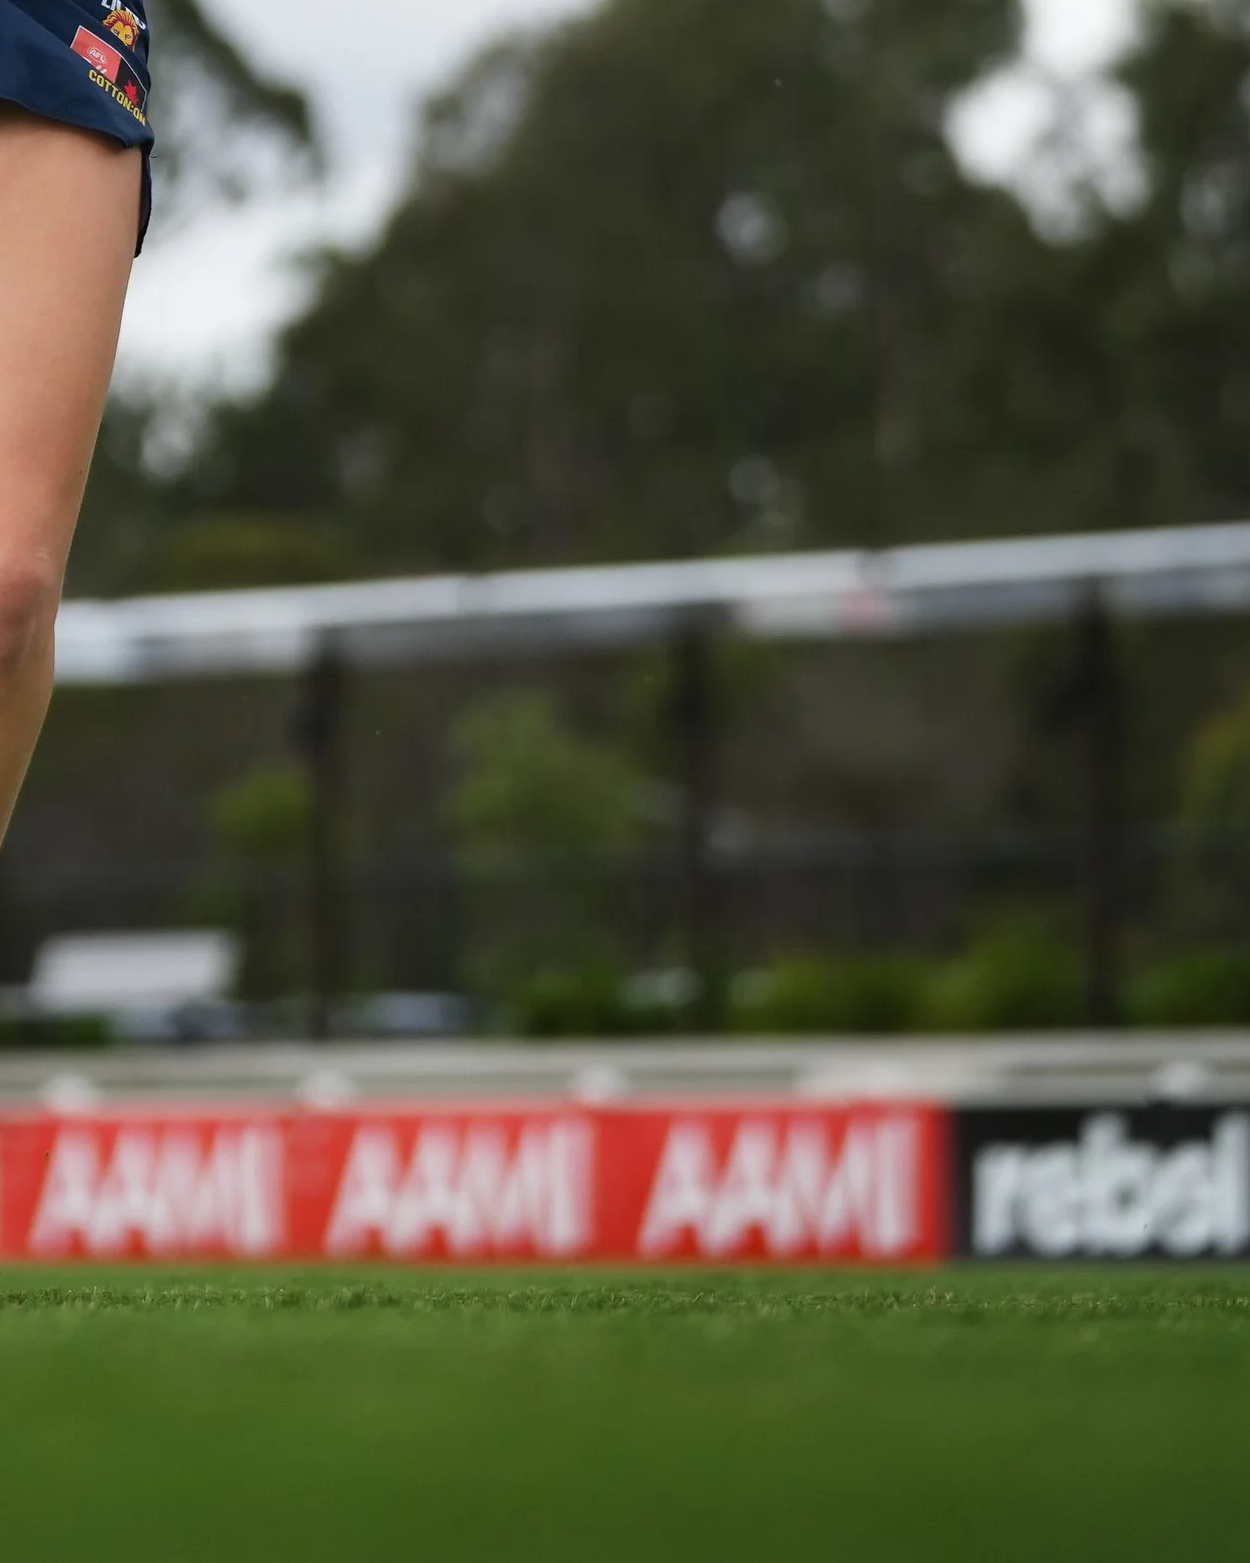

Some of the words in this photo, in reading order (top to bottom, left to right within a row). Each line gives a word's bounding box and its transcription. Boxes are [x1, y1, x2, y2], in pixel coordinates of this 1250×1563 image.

[88, 69, 146, 127] COTTON:ON
[89, 48, 107, 65] AFL
[28, 1125, 286, 1257] AAMI
[325, 1122, 596, 1256] AAMI
[639, 1116, 920, 1255] AAMI
